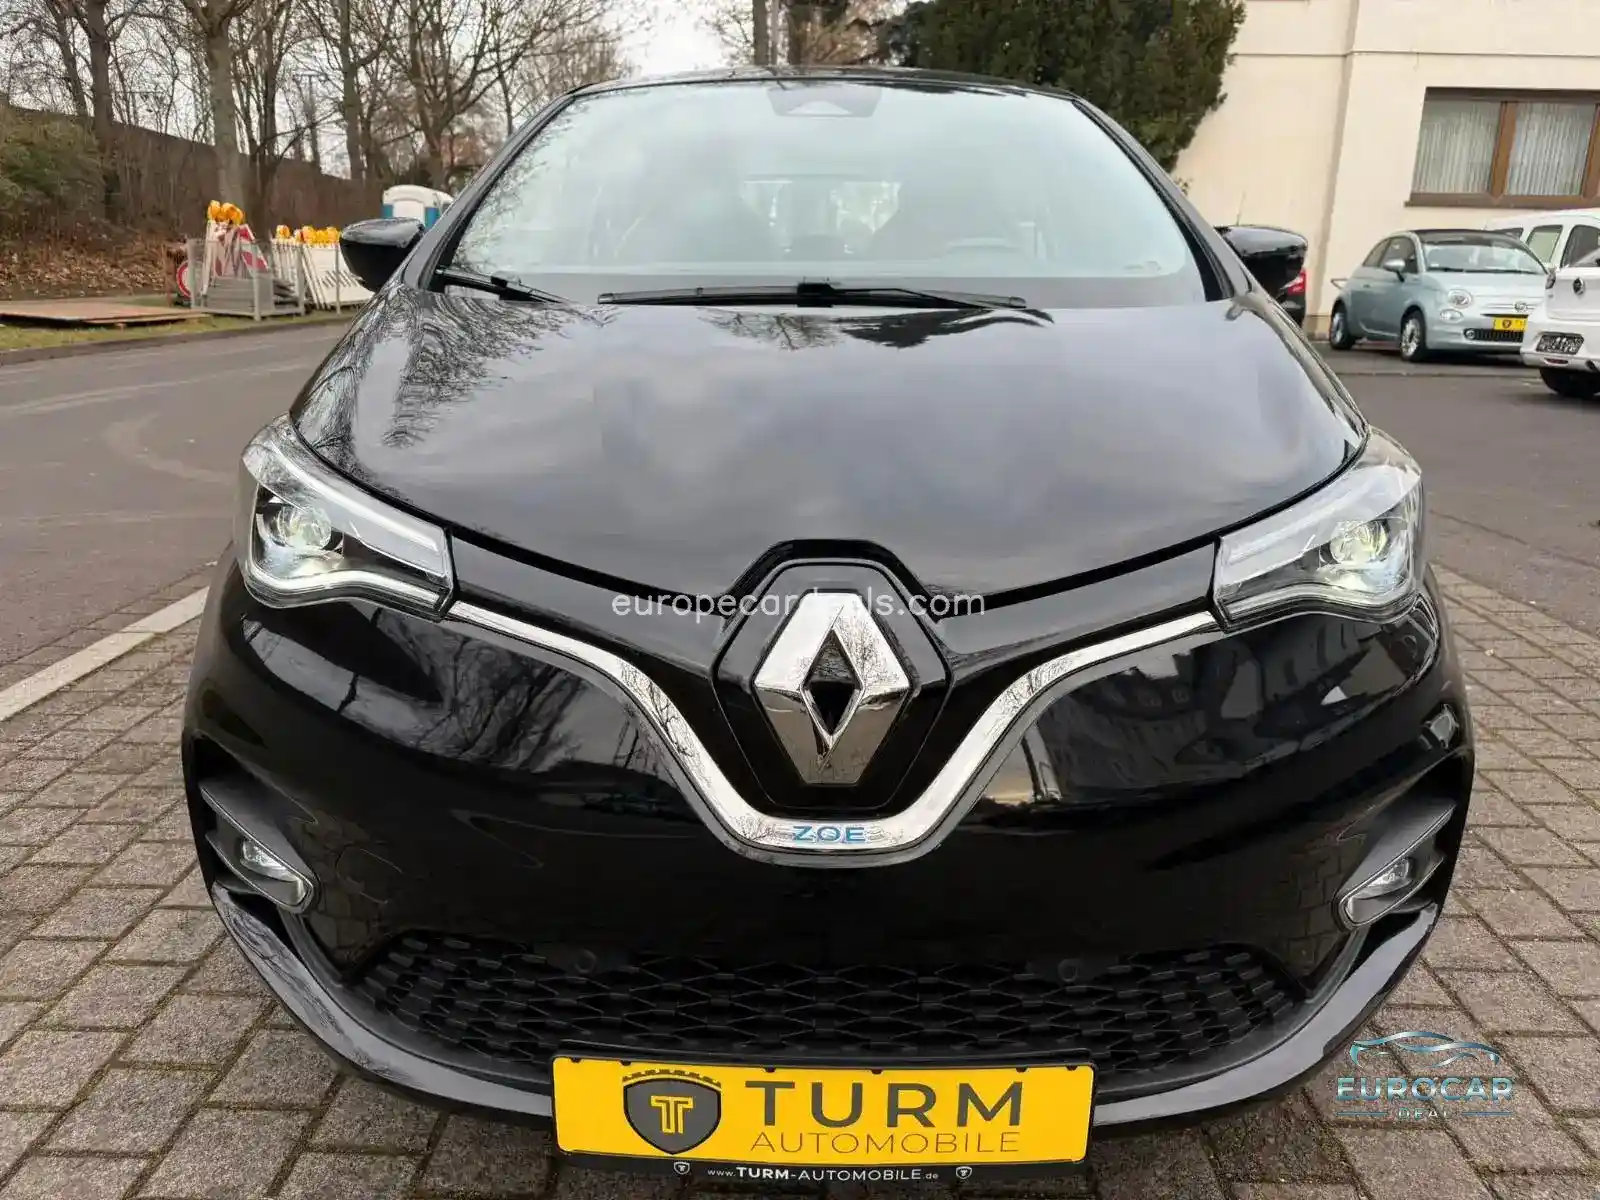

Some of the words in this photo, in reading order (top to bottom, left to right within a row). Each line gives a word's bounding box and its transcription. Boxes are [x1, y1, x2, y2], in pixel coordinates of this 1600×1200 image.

[793, 825, 865, 841] ZOE
[745, 1080, 1023, 1128] TURM
[750, 1131, 1021, 1154] AUTOMOBILE
[707, 1165, 939, 1182] www.TURM-AUTOMOBILE.de
